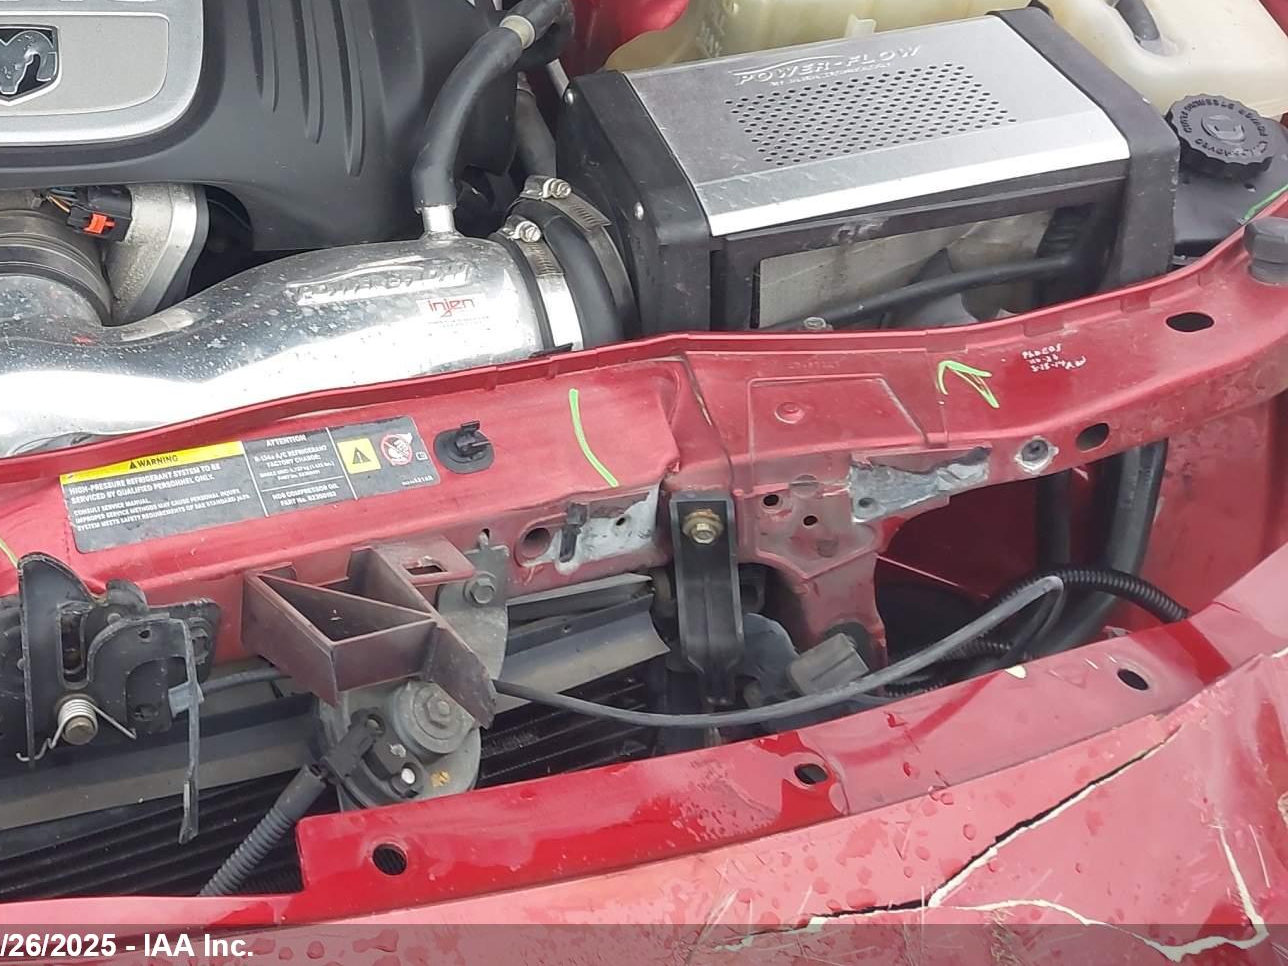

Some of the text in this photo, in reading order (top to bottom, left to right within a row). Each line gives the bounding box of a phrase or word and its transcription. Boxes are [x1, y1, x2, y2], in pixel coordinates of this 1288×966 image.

[428, 298, 475, 318] injen
[267, 435, 306, 447] ATTENTION
[138, 455, 178, 467] WARNING
[70, 480, 125, 495] HIGH-PRESSURE
[126, 472, 172, 485] REFRIGERANT
[173, 467, 200, 476] SYSTEM
[72, 492, 106, 503] SERVICED
[117, 484, 153, 496] QUALIFIED
[154, 478, 194, 489] PERSONNEL
[195, 474, 215, 482] ONLY.
[286, 485, 327, 497] COMPRESSOR
[76, 514, 105, 523] IMPROPER
[130, 505, 157, 513] METHODS
[190, 493, 220, 501] PERSONAL
[141, 507, 185, 518] REQUIREMENTS
[207, 498, 236, 506] STANDARD
[280, 498, 296, 506] PART
[74, 507, 100, 515] CONSULT
